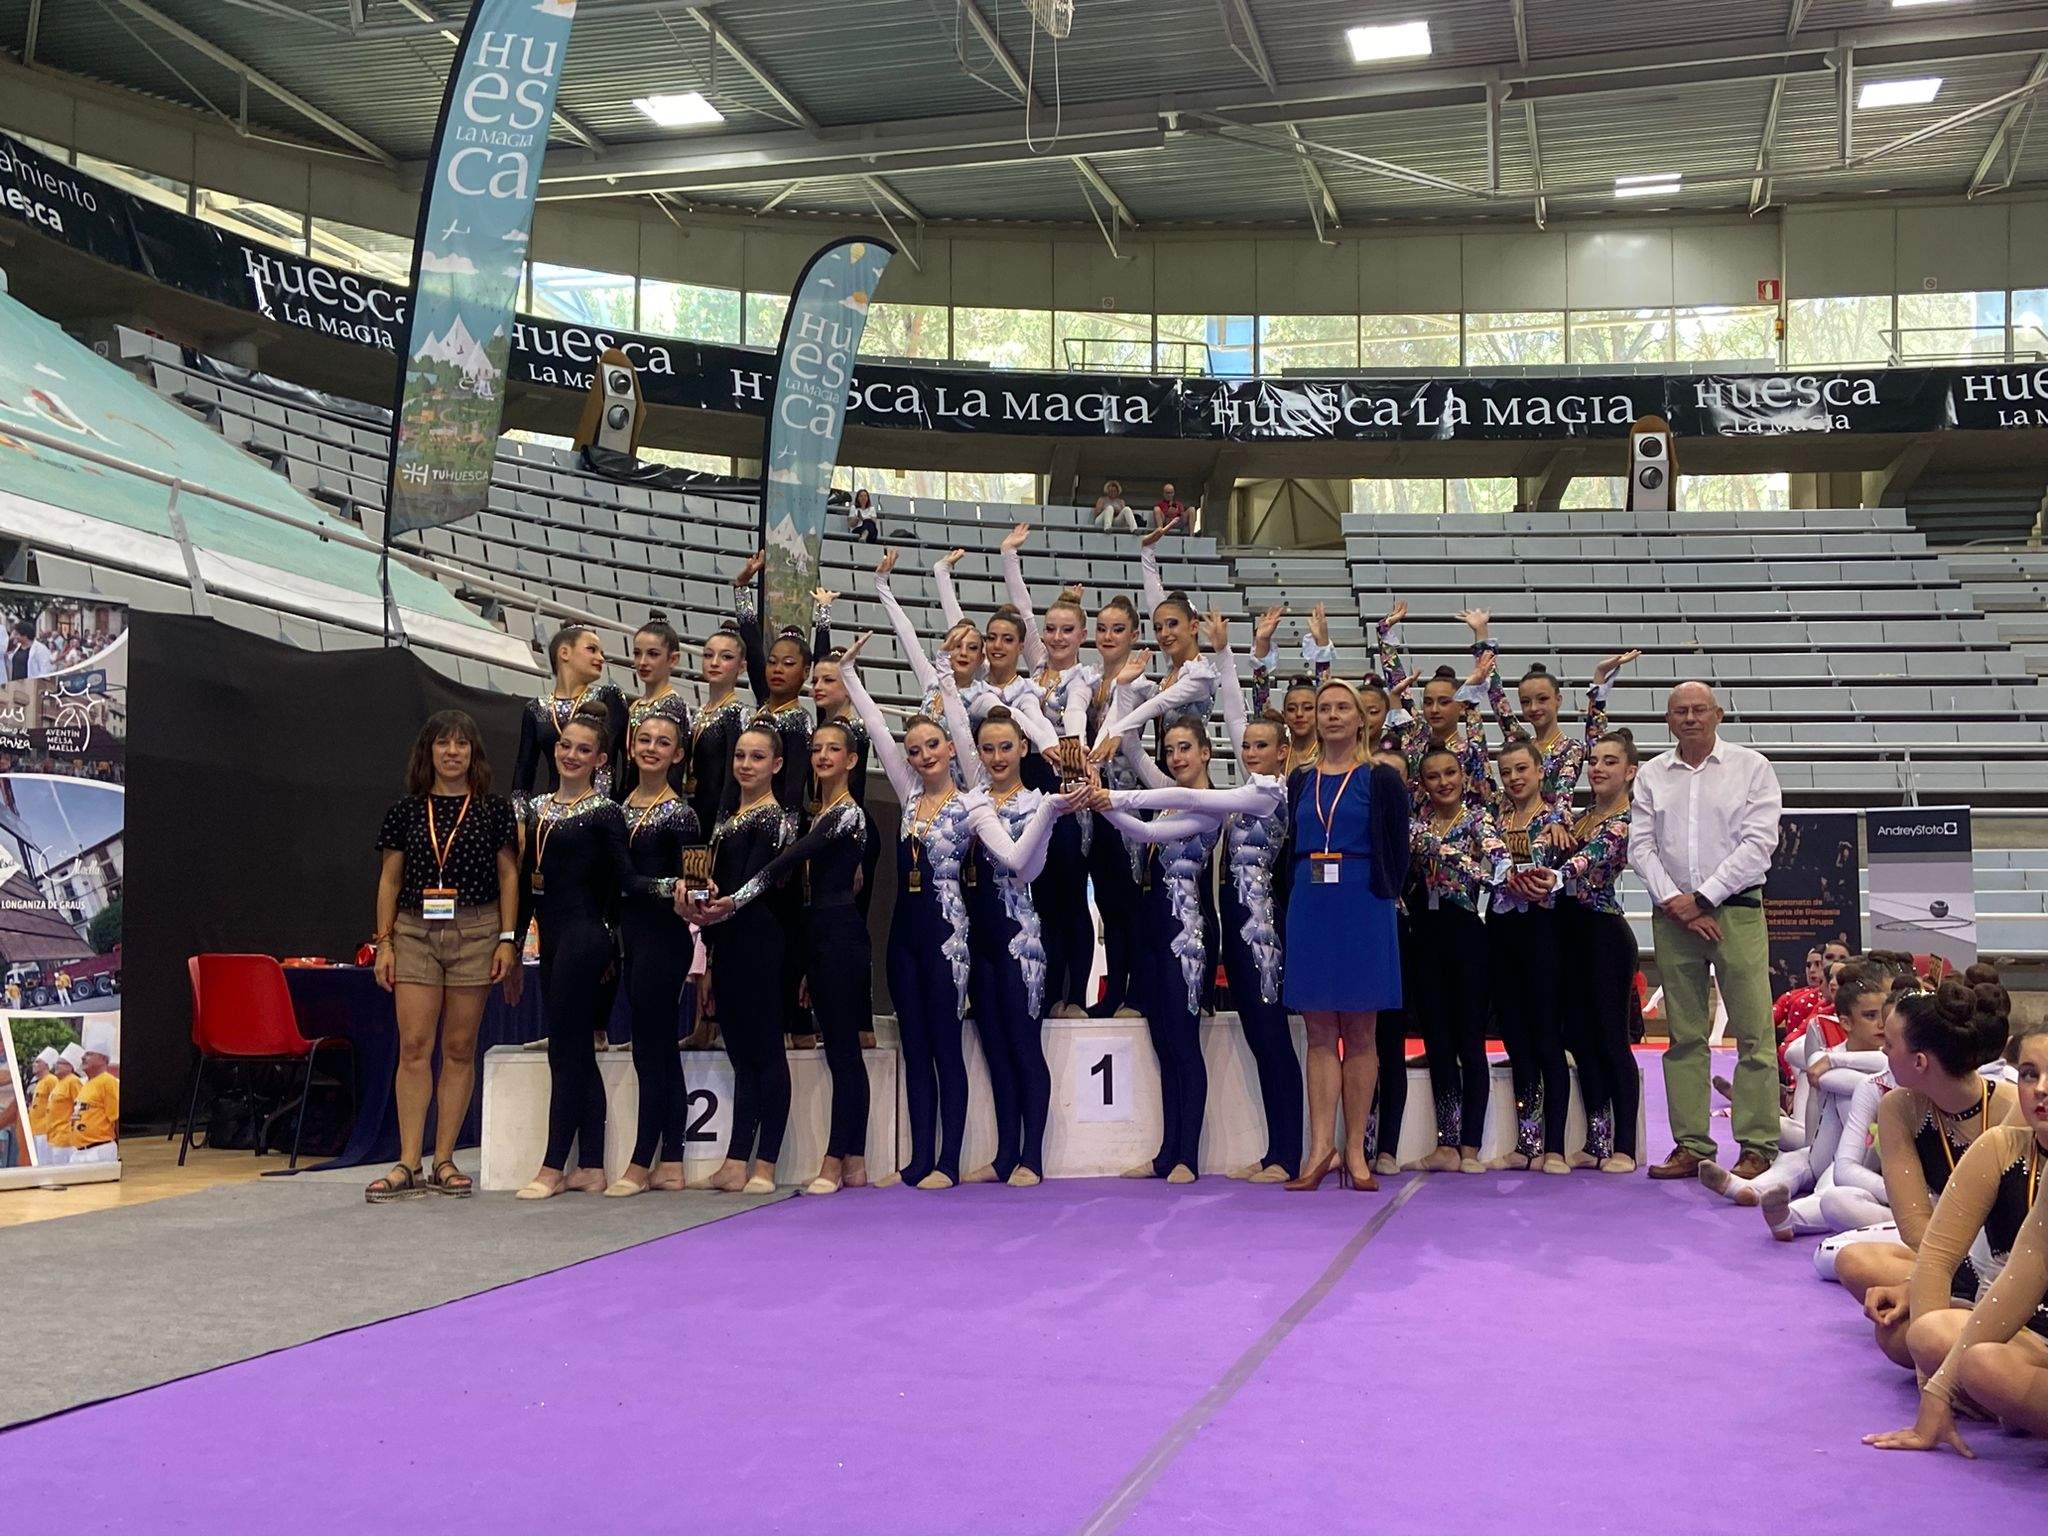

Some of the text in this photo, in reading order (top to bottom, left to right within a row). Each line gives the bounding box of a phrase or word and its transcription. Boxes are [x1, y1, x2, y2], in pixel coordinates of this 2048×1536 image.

[936, 387, 990, 418] La
[1693, 376, 1880, 409] Huesca
[431, 469, 489, 482] TUHUESCA
[47, 737, 73, 745] MELSA
[48, 744, 80, 753] MAELLA
[1, 900, 46, 910] LONGANIZA
[60, 900, 86, 910] GRAUS
[1091, 1054, 1113, 1105] 1
[685, 1089, 718, 1141] 2
